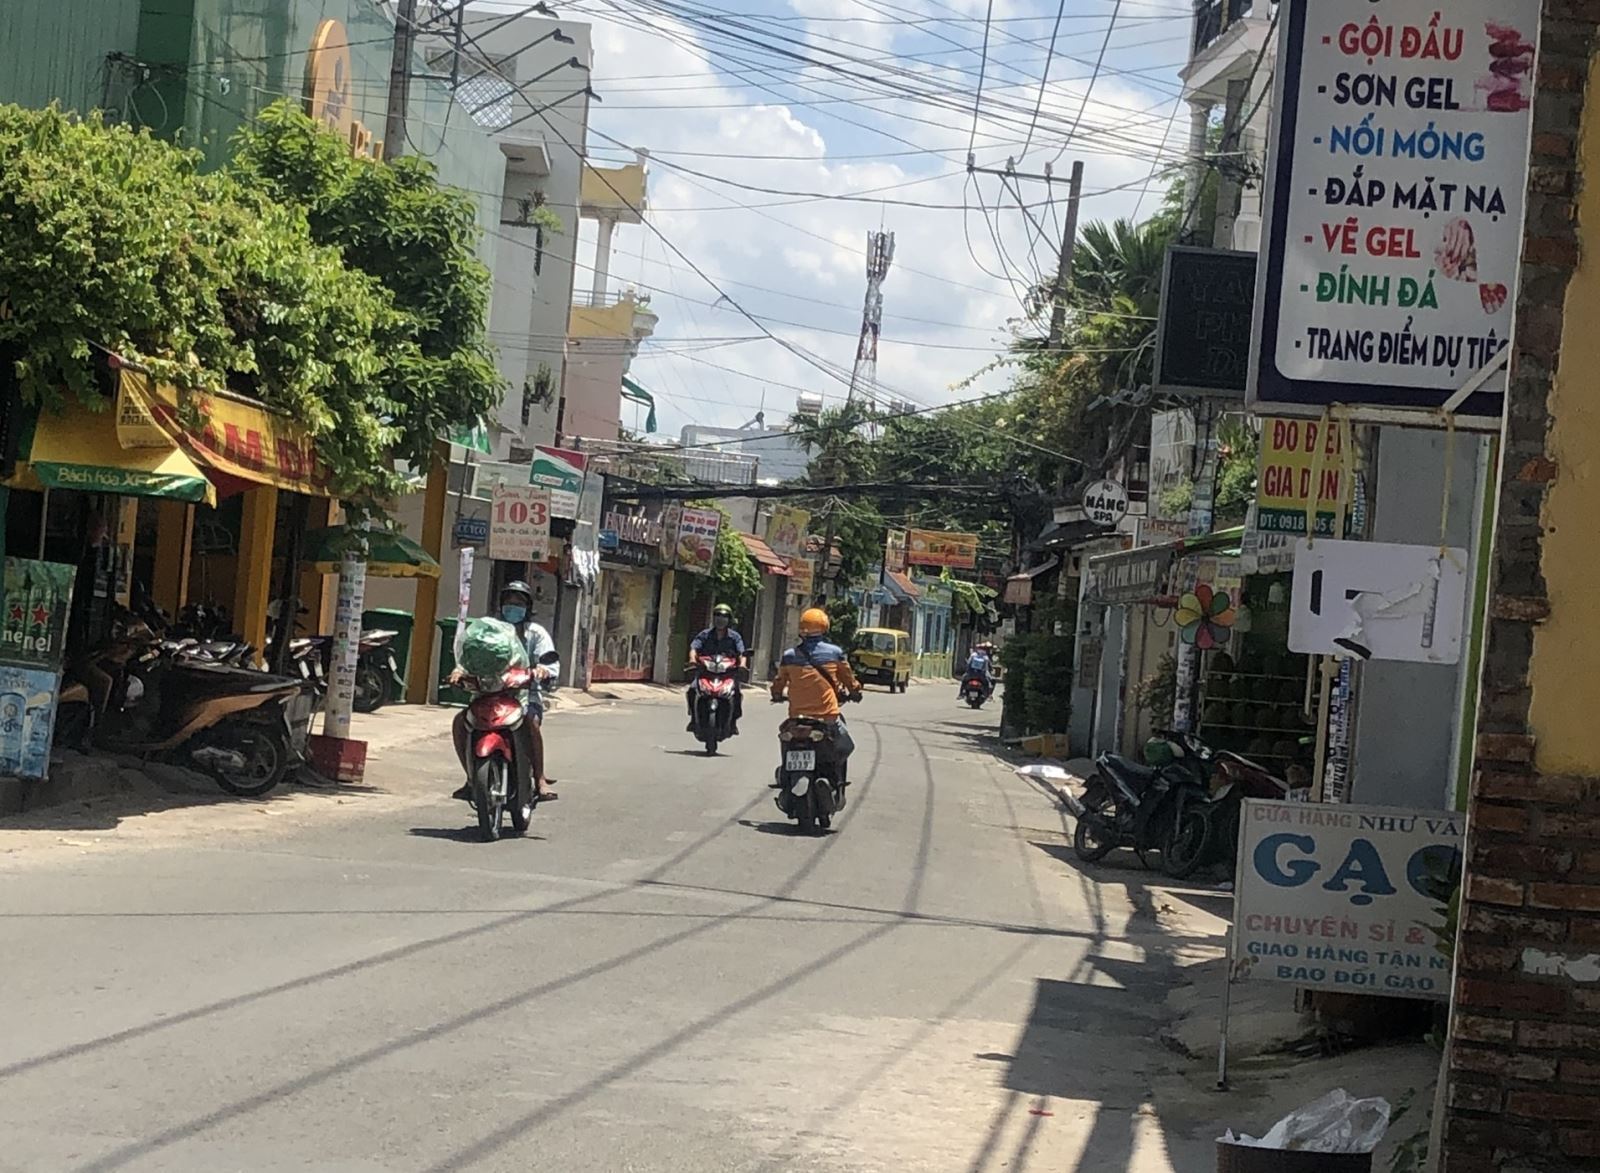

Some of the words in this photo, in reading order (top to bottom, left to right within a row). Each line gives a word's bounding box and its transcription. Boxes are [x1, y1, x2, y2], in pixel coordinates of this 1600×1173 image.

[1338, 14, 1393, 66] GỘI
[1400, 11, 1464, 61] ĐẦU
[1333, 72, 1398, 108] SƠN
[1404, 76, 1460, 111] GEL
[1330, 112, 1385, 157] NỐI
[1391, 121, 1485, 162] MÓNG
[1325, 164, 1386, 208] ĐẮP
[1393, 176, 1458, 219] MẶT
[1464, 184, 1507, 223] NẠ
[1321, 216, 1359, 255] VẼ
[1366, 226, 1421, 258] GEL
[1316, 264, 1390, 306] ĐÍNH
[1397, 269, 1439, 309] ĐÁ
[1307, 327, 1374, 362] TRANG
[1379, 316, 1428, 366] ĐIỂM
[1432, 335, 1464, 377] DỰ
[57, 467, 92, 482] Bách
[95, 471, 119, 486] hóa
[1264, 465, 1293, 498] GIA
[494, 501, 547, 526] 103
[1093, 510, 1113, 521] SPA
[1358, 815, 1418, 833] NHƯ
[1245, 914, 1358, 939] CHUYÊN
[1404, 926, 1425, 944] &
[1247, 941, 1299, 958] GIAO
[1306, 944, 1369, 964] HÀNG
[1375, 950, 1420, 969] TẬN
[1429, 955, 1447, 969] N
[1277, 965, 1326, 981] BAO
